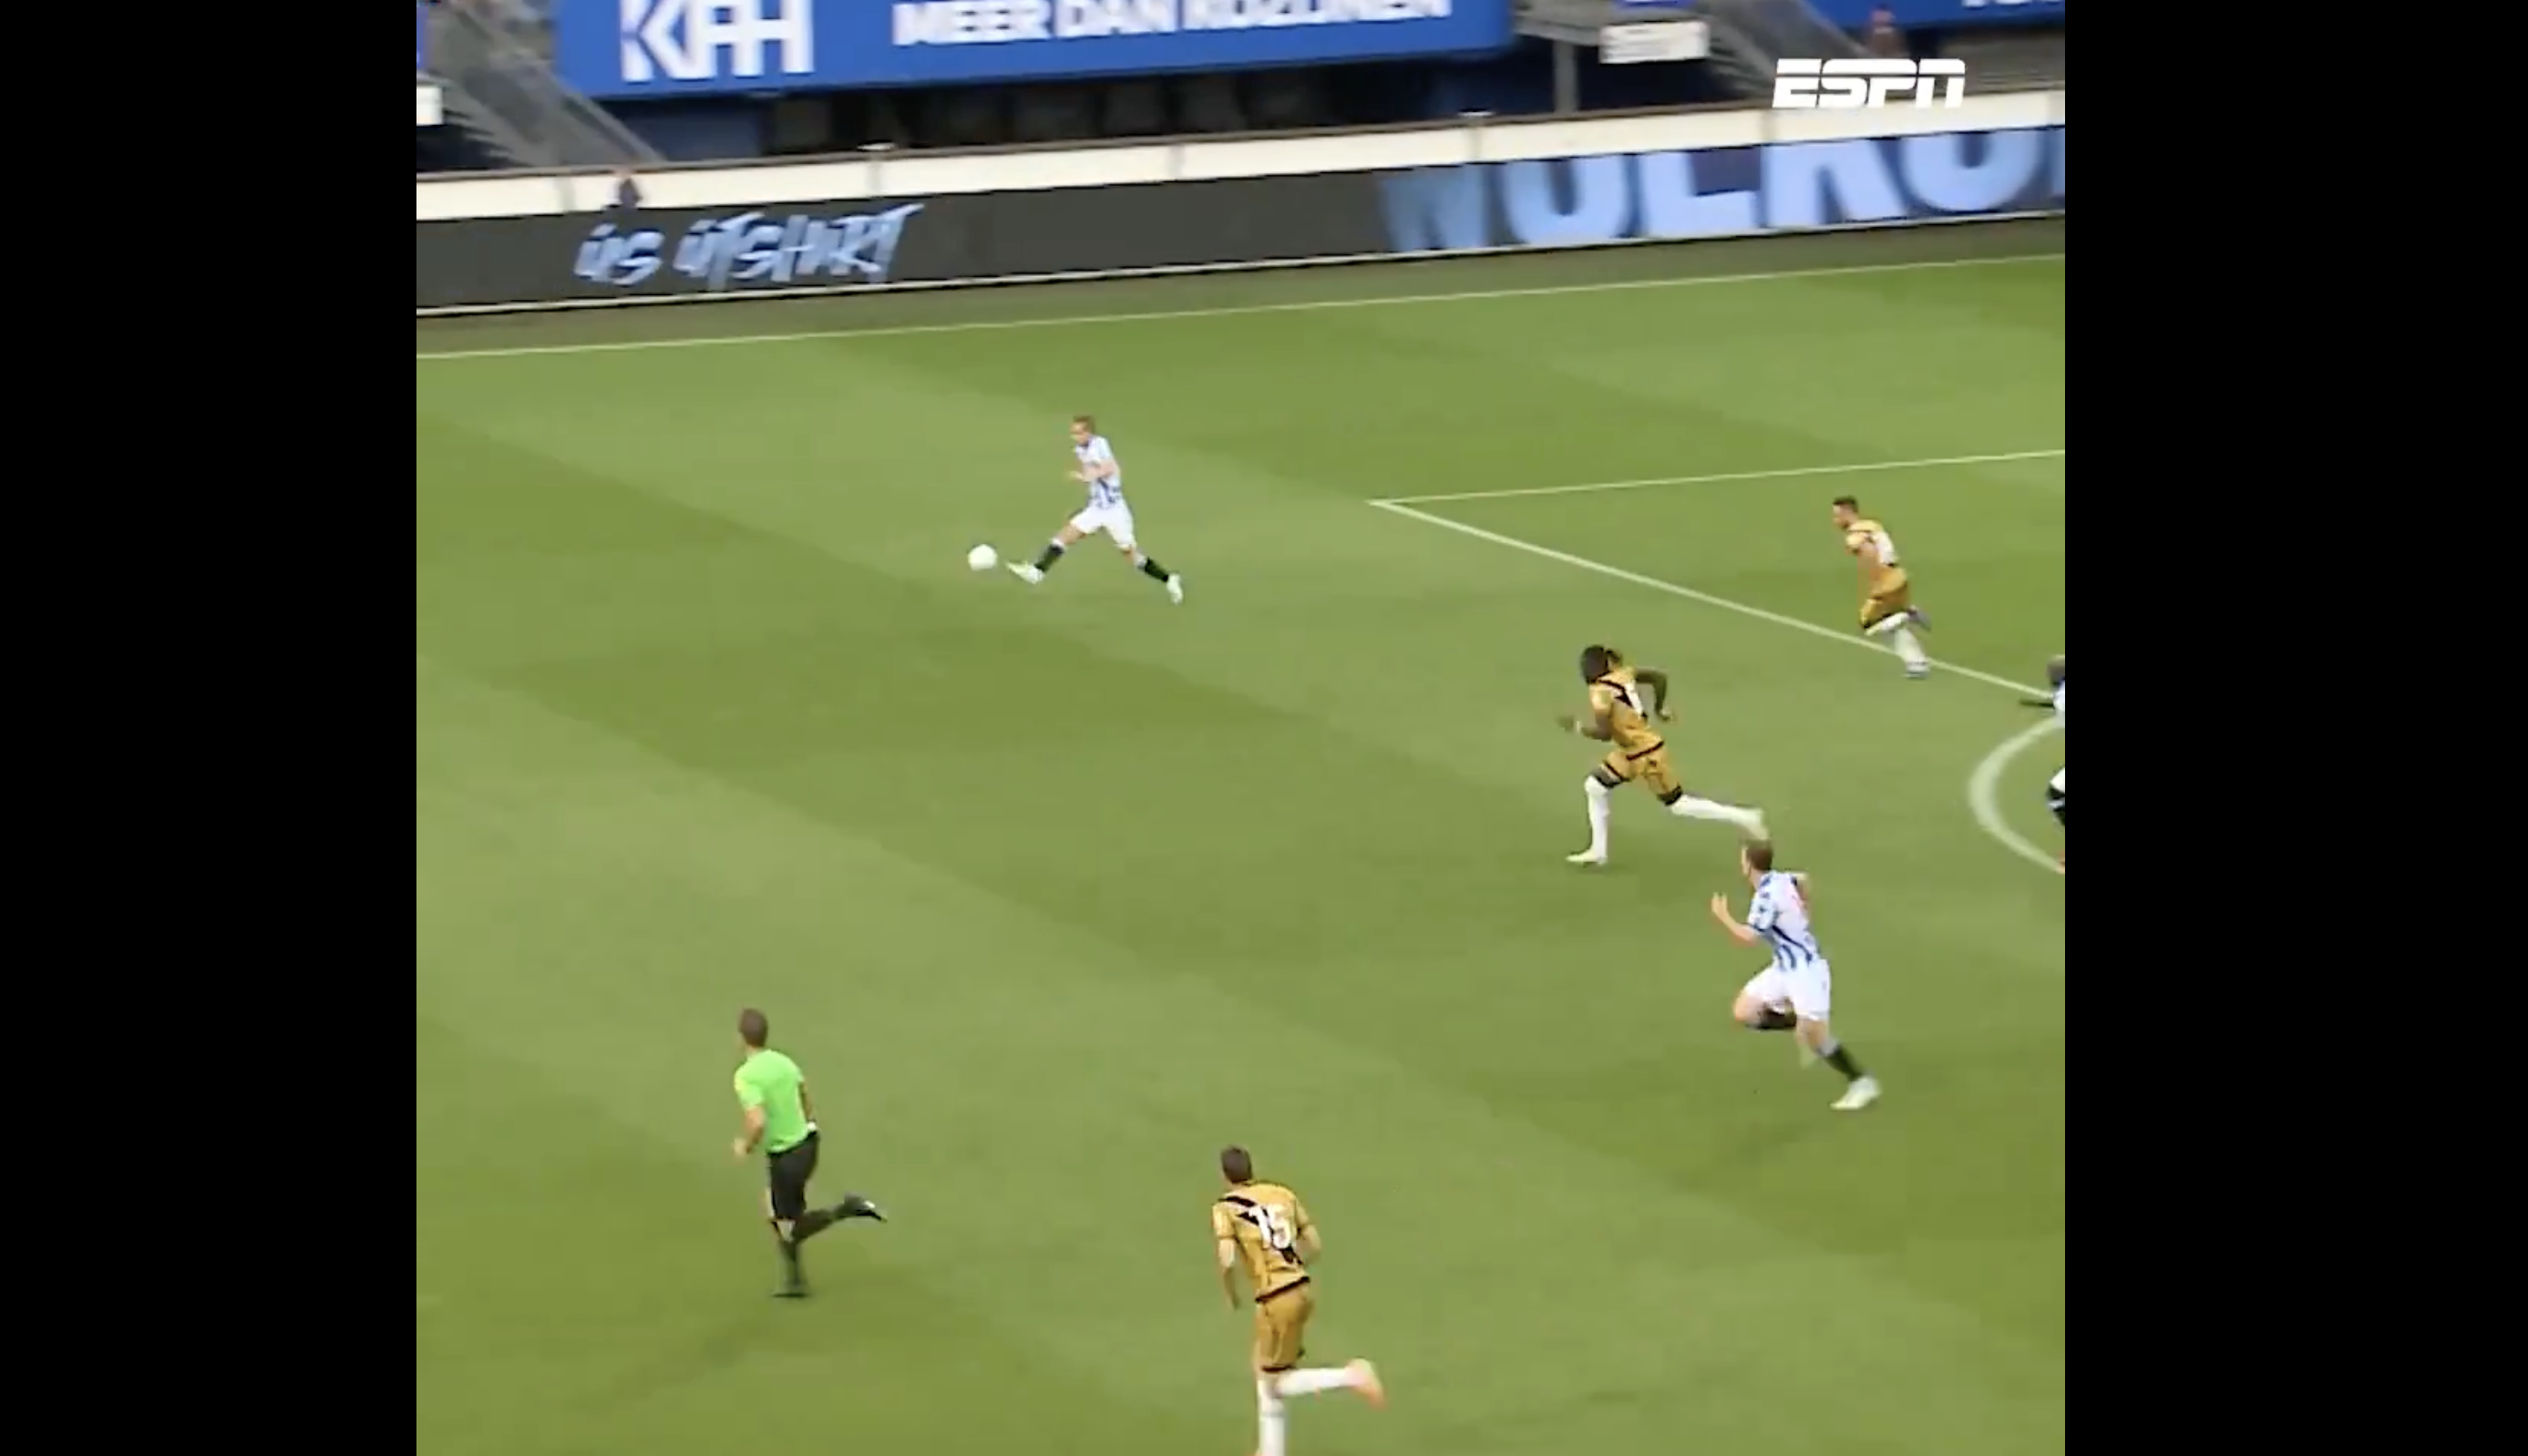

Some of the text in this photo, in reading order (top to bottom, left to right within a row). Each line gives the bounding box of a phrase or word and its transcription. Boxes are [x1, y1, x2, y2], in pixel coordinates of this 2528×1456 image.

[891, 1, 1050, 45] MEER
[1053, 0, 1177, 38] DAN
[1378, 127, 2065, 252] WOLKO
[1249, 1203, 1292, 1250] 15
